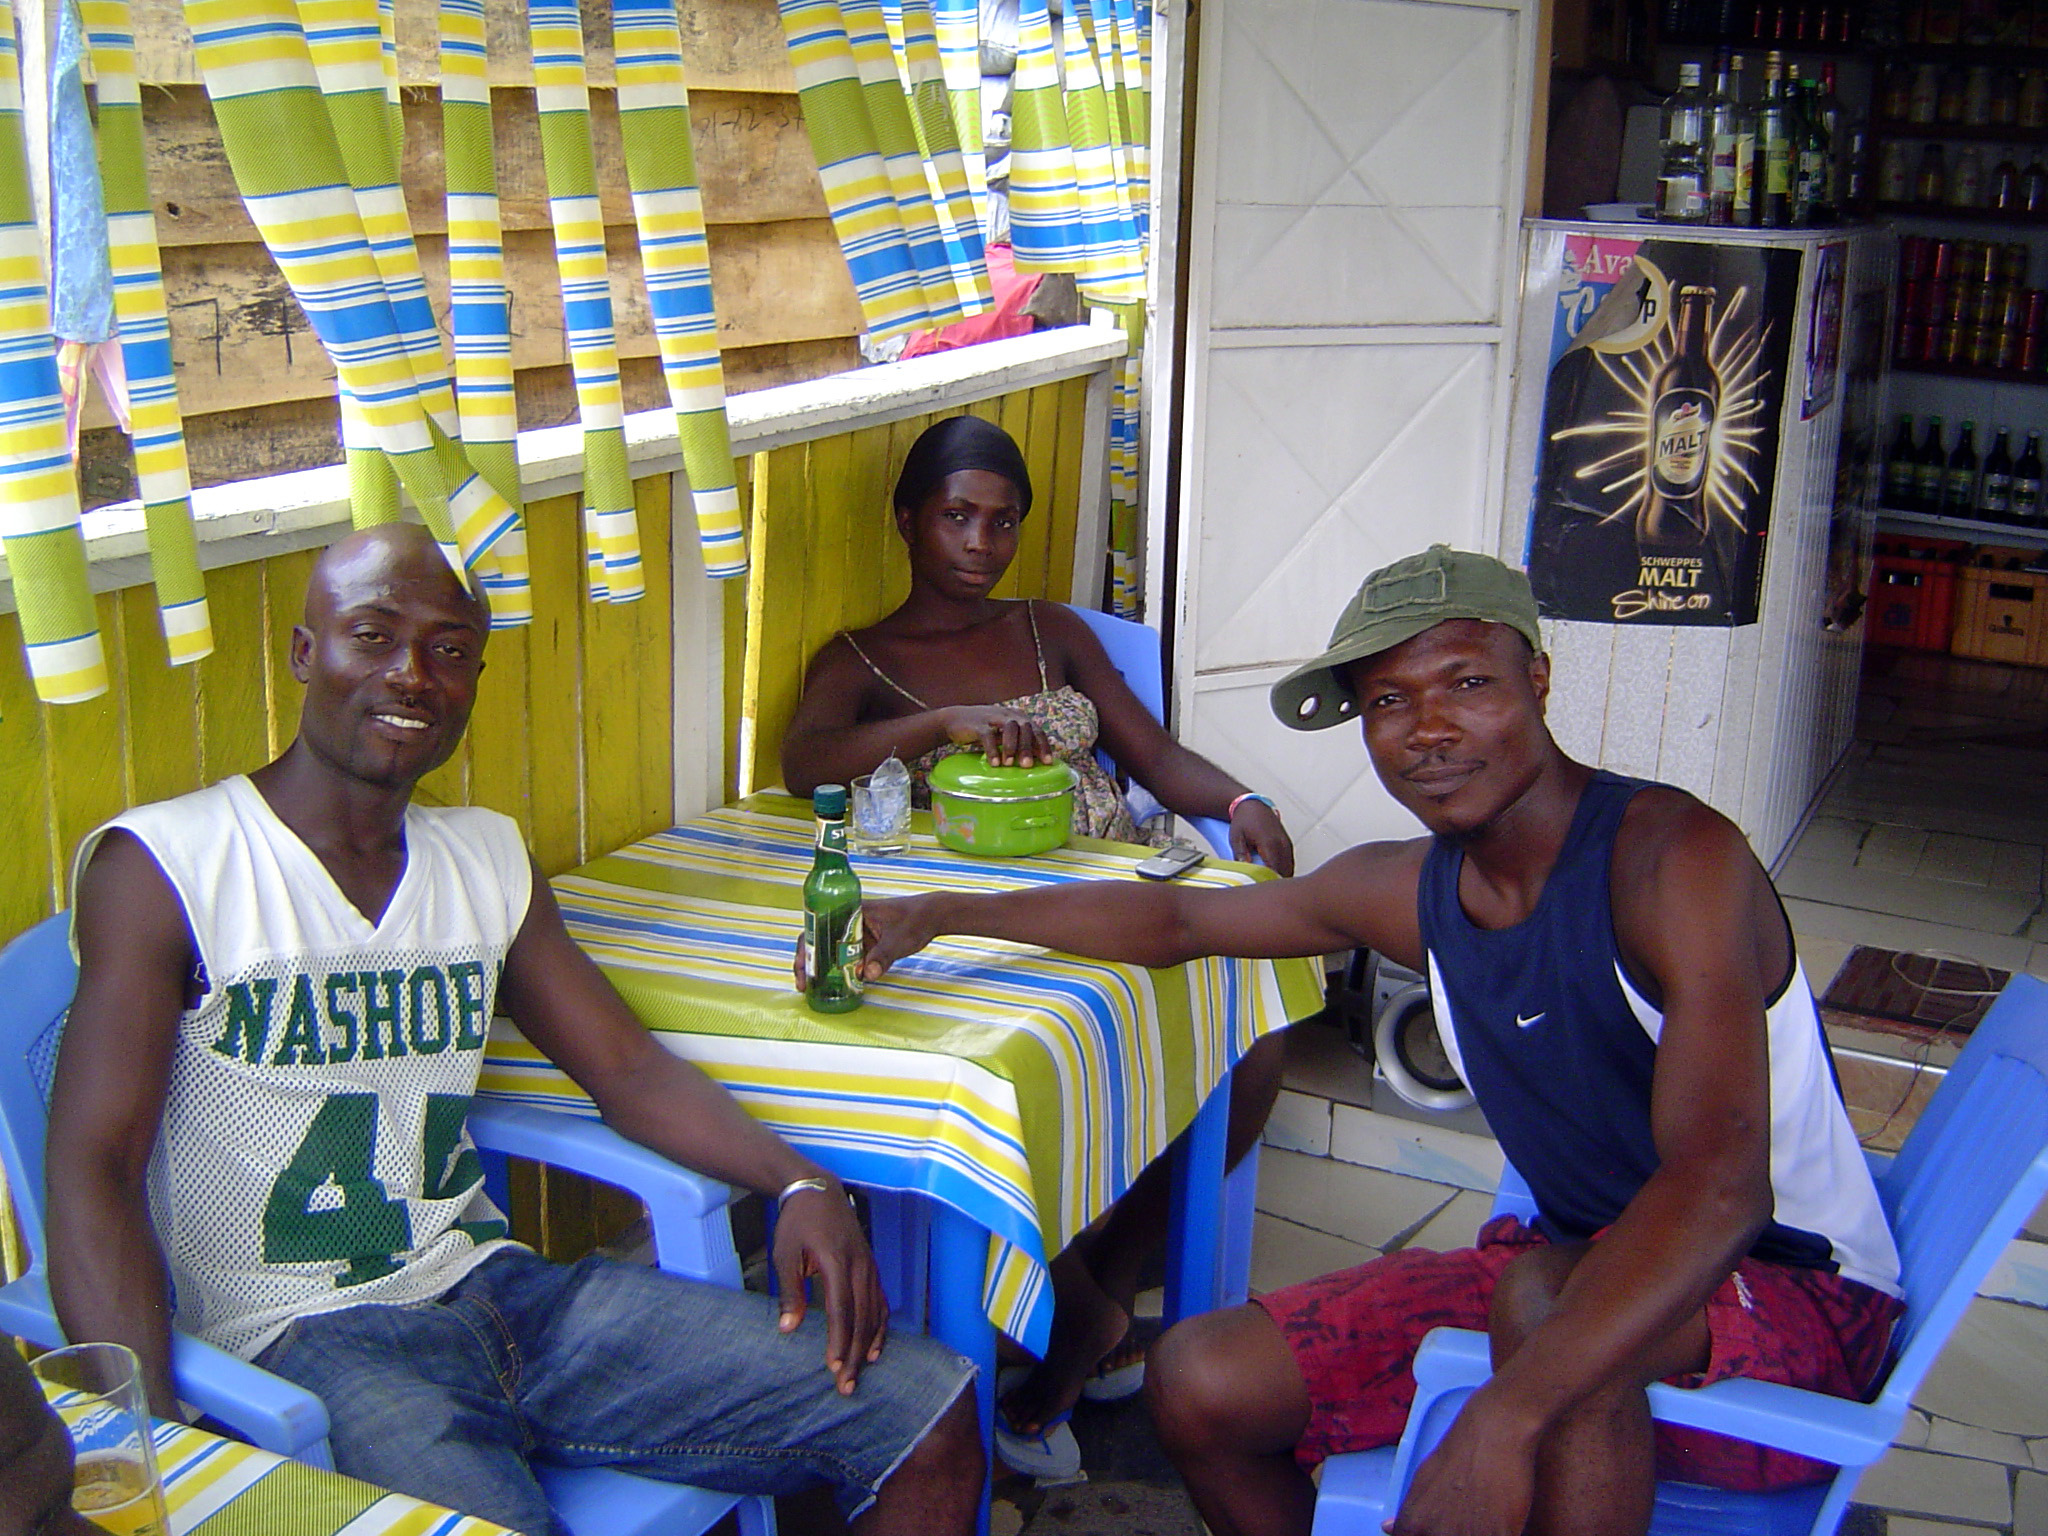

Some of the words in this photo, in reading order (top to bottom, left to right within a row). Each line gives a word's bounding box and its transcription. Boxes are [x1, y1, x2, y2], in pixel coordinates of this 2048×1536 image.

[1659, 429, 1707, 458] MALT
[1641, 556, 1703, 568] SCHWEPPES
[1638, 567, 1702, 588] MALT
